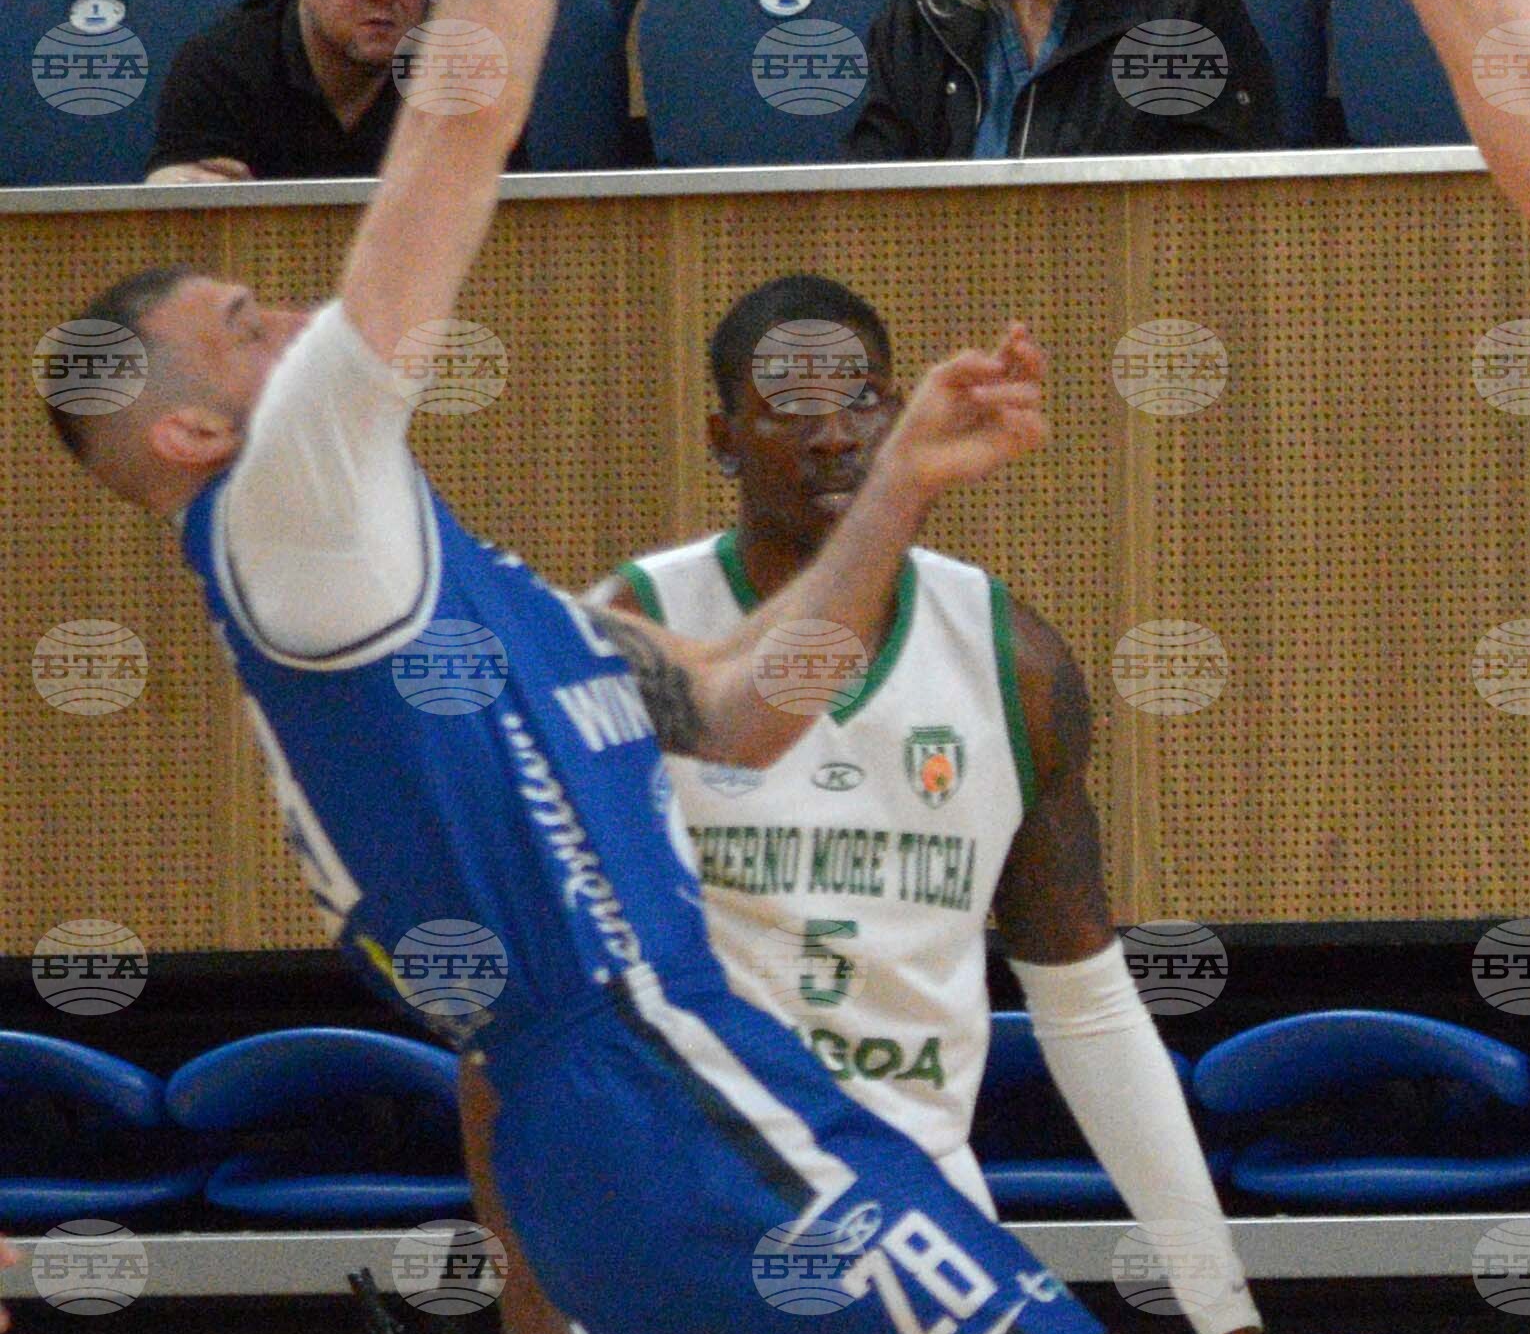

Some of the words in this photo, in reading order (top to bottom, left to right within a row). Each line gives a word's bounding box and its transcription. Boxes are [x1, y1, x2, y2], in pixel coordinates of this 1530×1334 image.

[808, 826, 890, 898] MORE
[899, 832, 977, 912] TICHA
[799, 920, 858, 1008] 5
